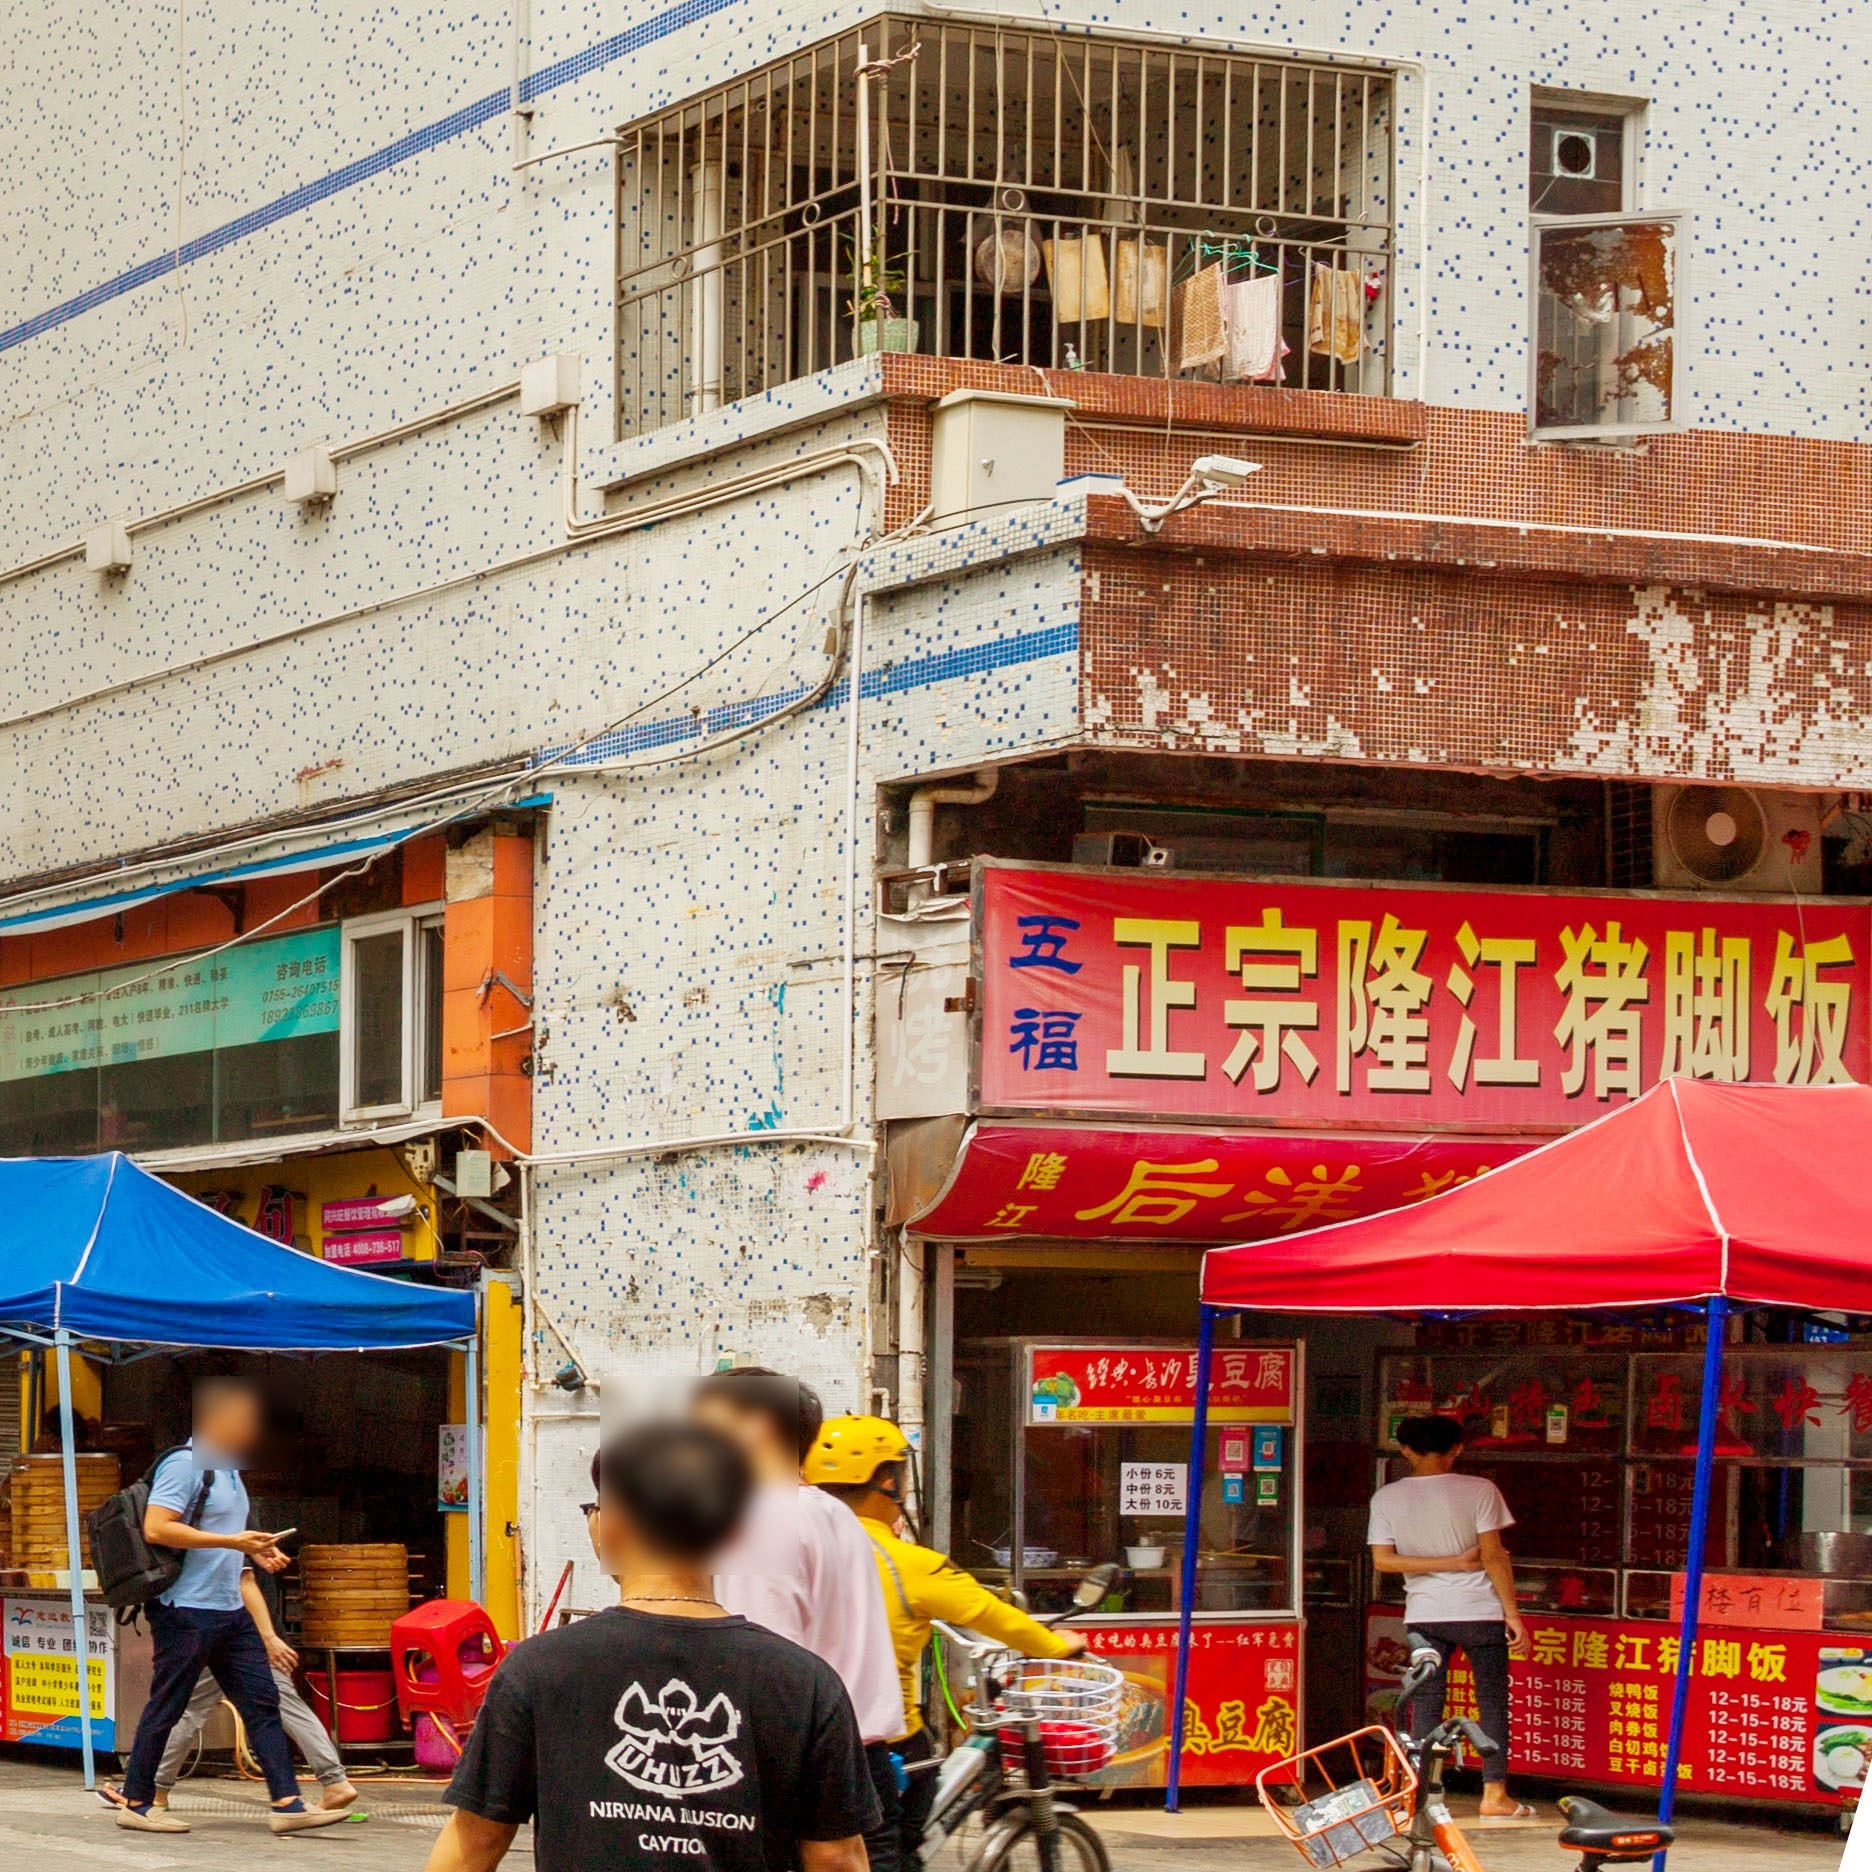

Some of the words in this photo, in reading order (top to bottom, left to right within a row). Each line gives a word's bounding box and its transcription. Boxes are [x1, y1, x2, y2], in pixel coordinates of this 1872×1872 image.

[276, 955, 328, 981] 咨询电话
[1008, 914, 1083, 1073] 五福
[1106, 907, 1855, 1100] 正宗隆江猪脚饭
[983, 1151, 1070, 1230] 隆江
[1126, 1468, 1152, 1480] 小份
[1154, 1468, 1176, 1480] 6元
[1125, 1483, 1152, 1495] 中份
[1154, 1483, 1176, 1495] 8元
[1125, 1499, 1152, 1511] 大份
[1154, 1499, 1184, 1511] 10元
[1676, 1586, 1806, 1615] 楼有位
[11, 1635, 31, 1649] 诚信
[37, 1636, 56, 1650] 专业
[88, 1639, 107, 1654] 协作
[1608, 1681, 1659, 1702] 烧鸭饭
[1709, 1690, 1808, 1714] 12-15-18元
[1608, 1700, 1658, 1720] 叉烧饭
[1709, 1710, 1807, 1733] 12-15-18元
[1708, 1729, 1807, 1753] 12-15-18元
[1707, 1748, 1806, 1773] 12-15-18元
[1706, 1768, 1806, 1792] 12-15-18元
[589, 1800, 676, 1824] NIRVANA
